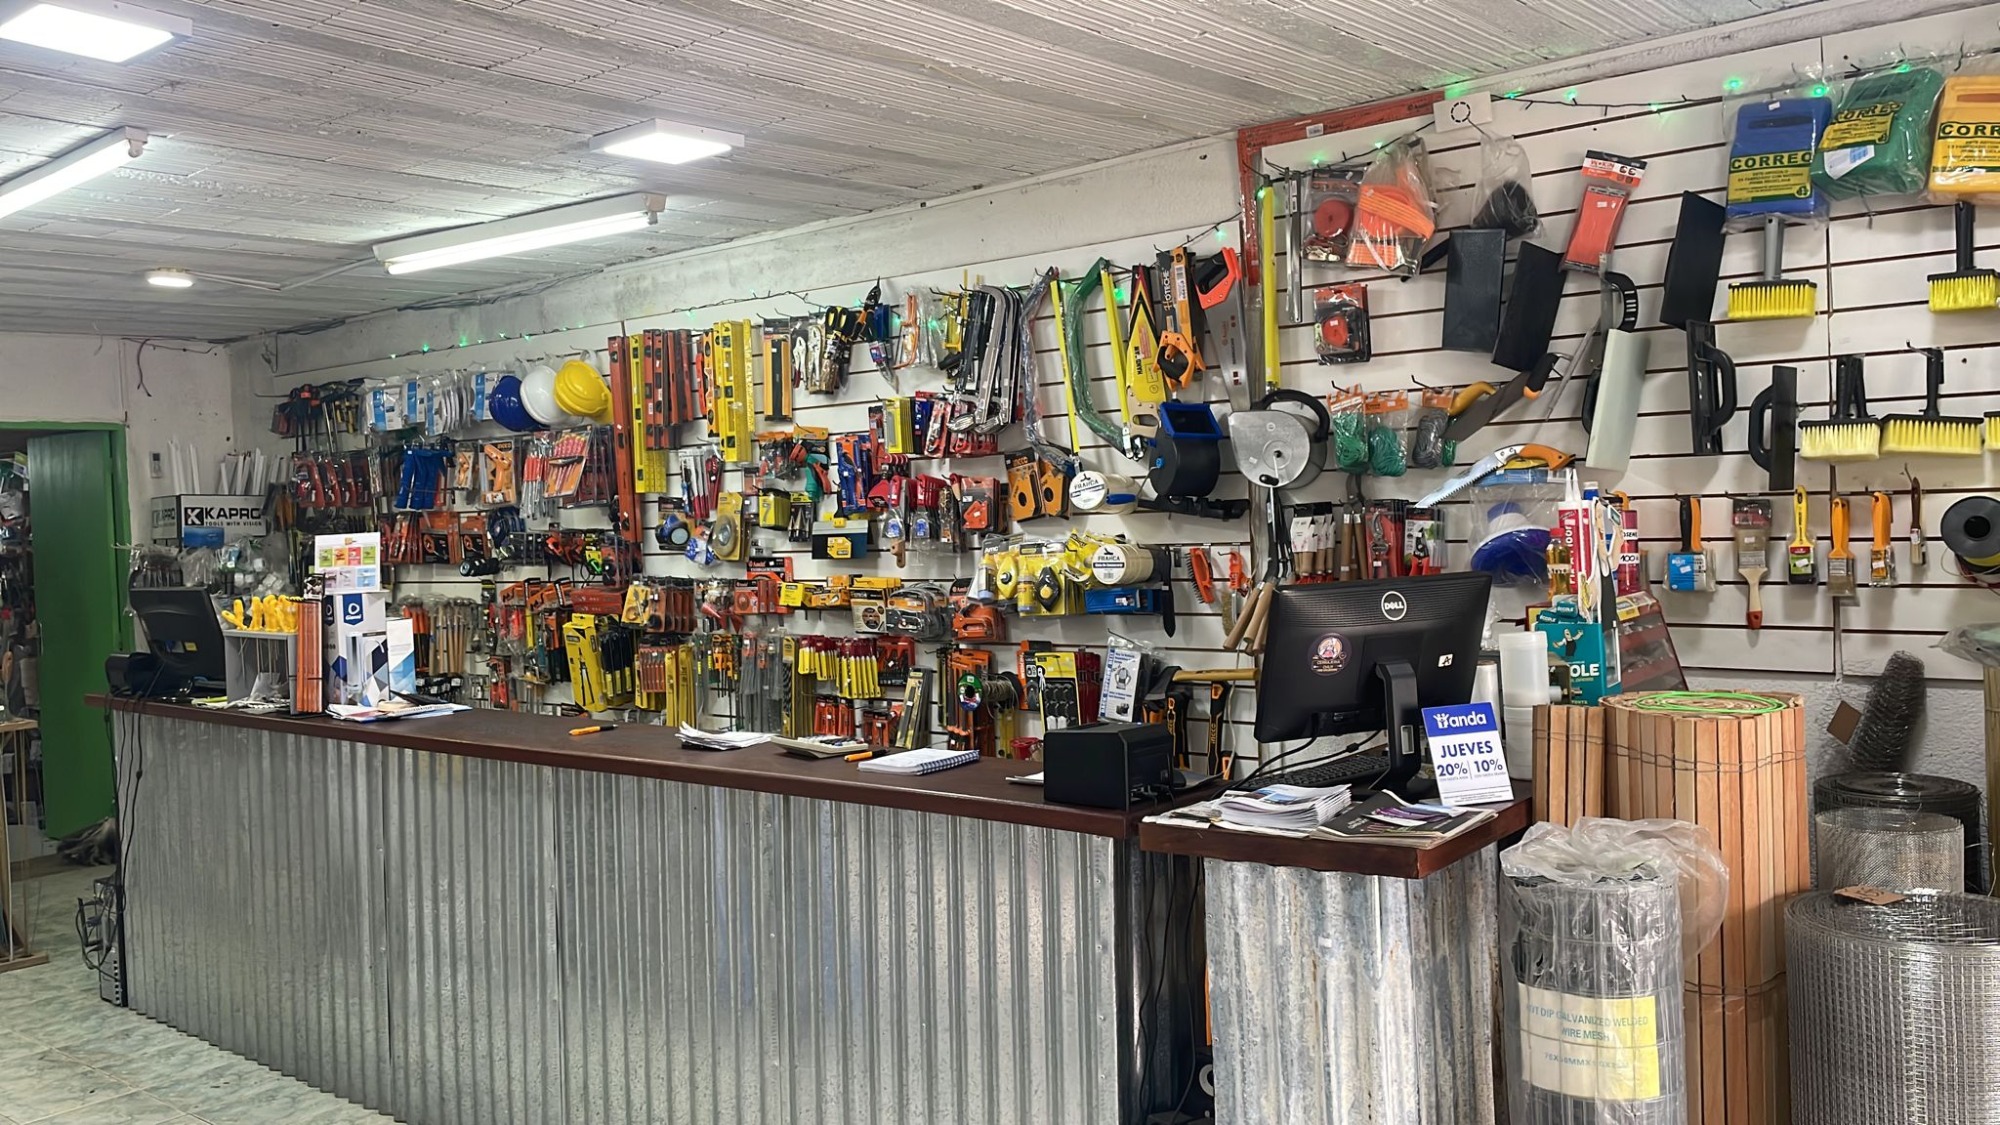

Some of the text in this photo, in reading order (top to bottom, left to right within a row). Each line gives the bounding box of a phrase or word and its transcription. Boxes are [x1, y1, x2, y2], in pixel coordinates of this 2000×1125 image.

[205, 507, 261, 519] KAPRO
[1384, 602, 1403, 610] DELL
[1449, 711, 1487, 727] anda
[1440, 741, 1493, 758] JUEVES
[1437, 762, 1468, 777] 20%
[1474, 759, 1503, 772] 10%
[1541, 1009, 1555, 1018] DIP
[1561, 1027, 1610, 1041] WIRE MESH
